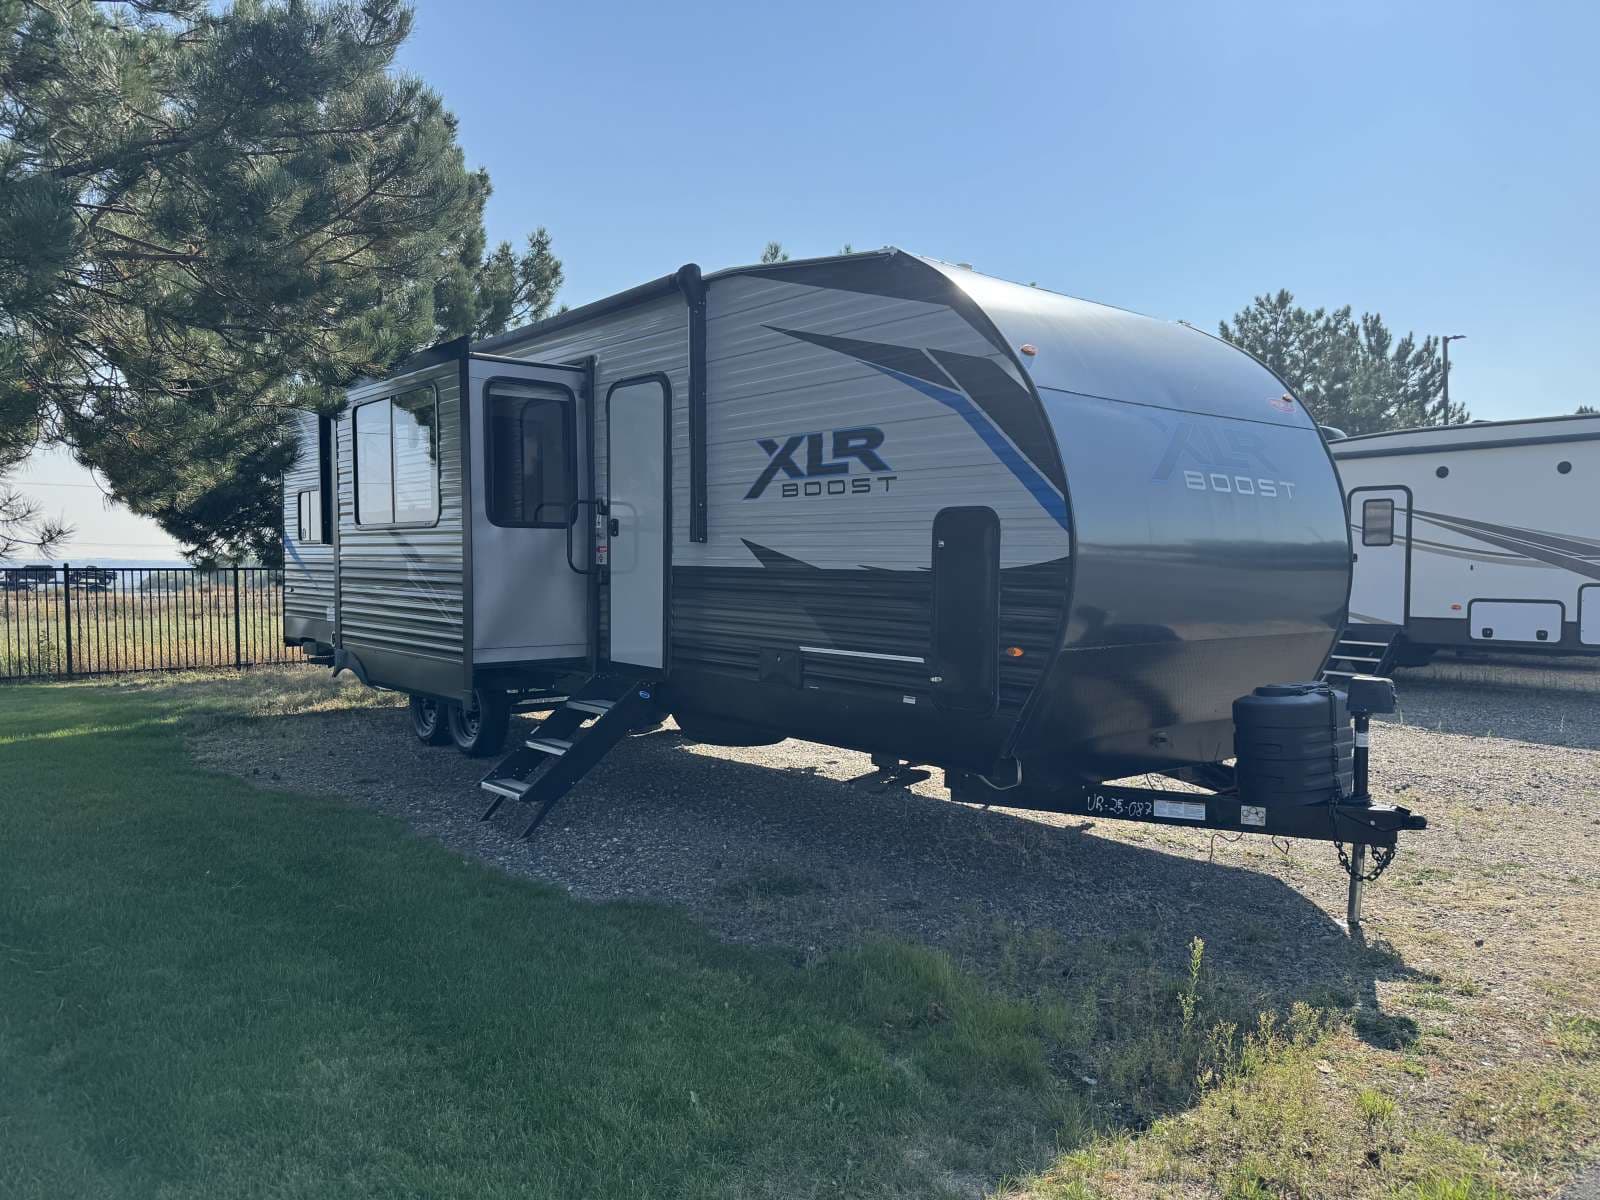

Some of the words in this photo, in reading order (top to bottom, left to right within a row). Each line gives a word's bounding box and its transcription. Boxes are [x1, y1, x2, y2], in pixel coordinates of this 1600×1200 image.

[743, 426, 892, 501] XLR
[1151, 418, 1281, 482] XLR
[782, 476, 897, 498] BOOST
[1184, 470, 1296, 499] BOOST
